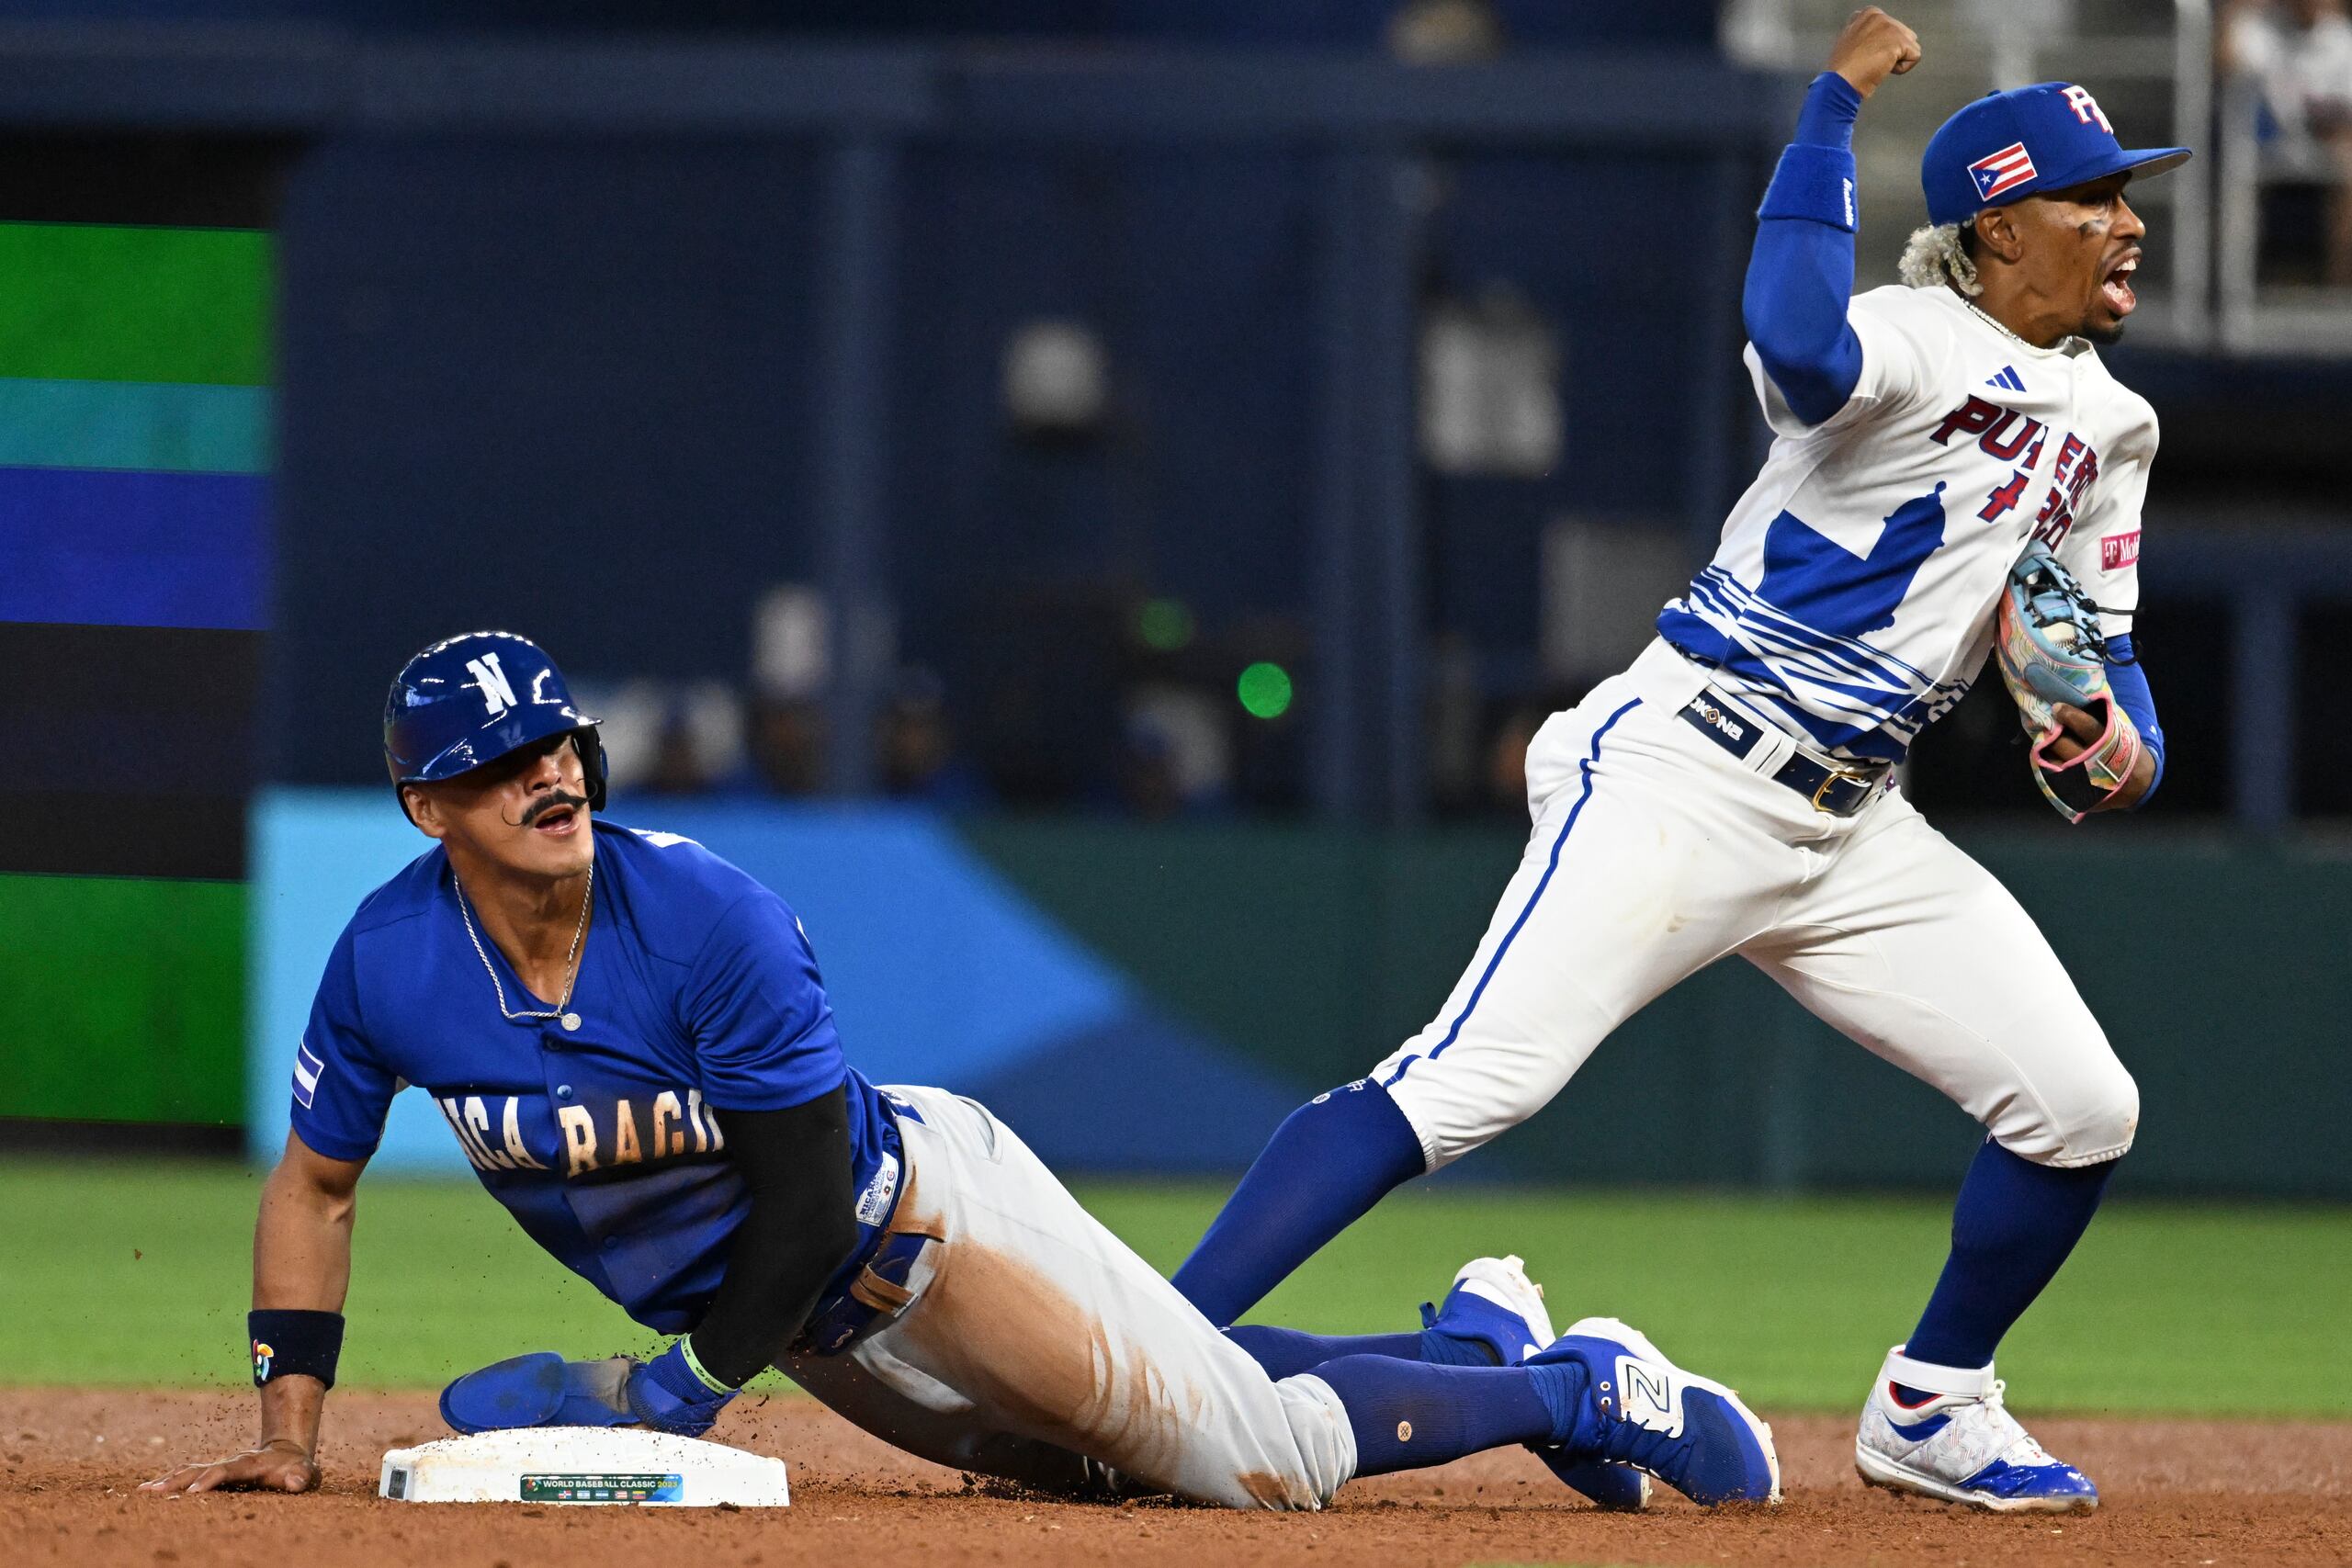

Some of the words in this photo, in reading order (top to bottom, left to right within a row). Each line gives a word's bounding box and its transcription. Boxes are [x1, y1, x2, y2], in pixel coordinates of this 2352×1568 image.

[466, 651, 518, 715] N
[543, 1480, 574, 1488] WORLD
[575, 1480, 619, 1488] BASEBALL
[620, 1480, 656, 1488] CLASSIC
